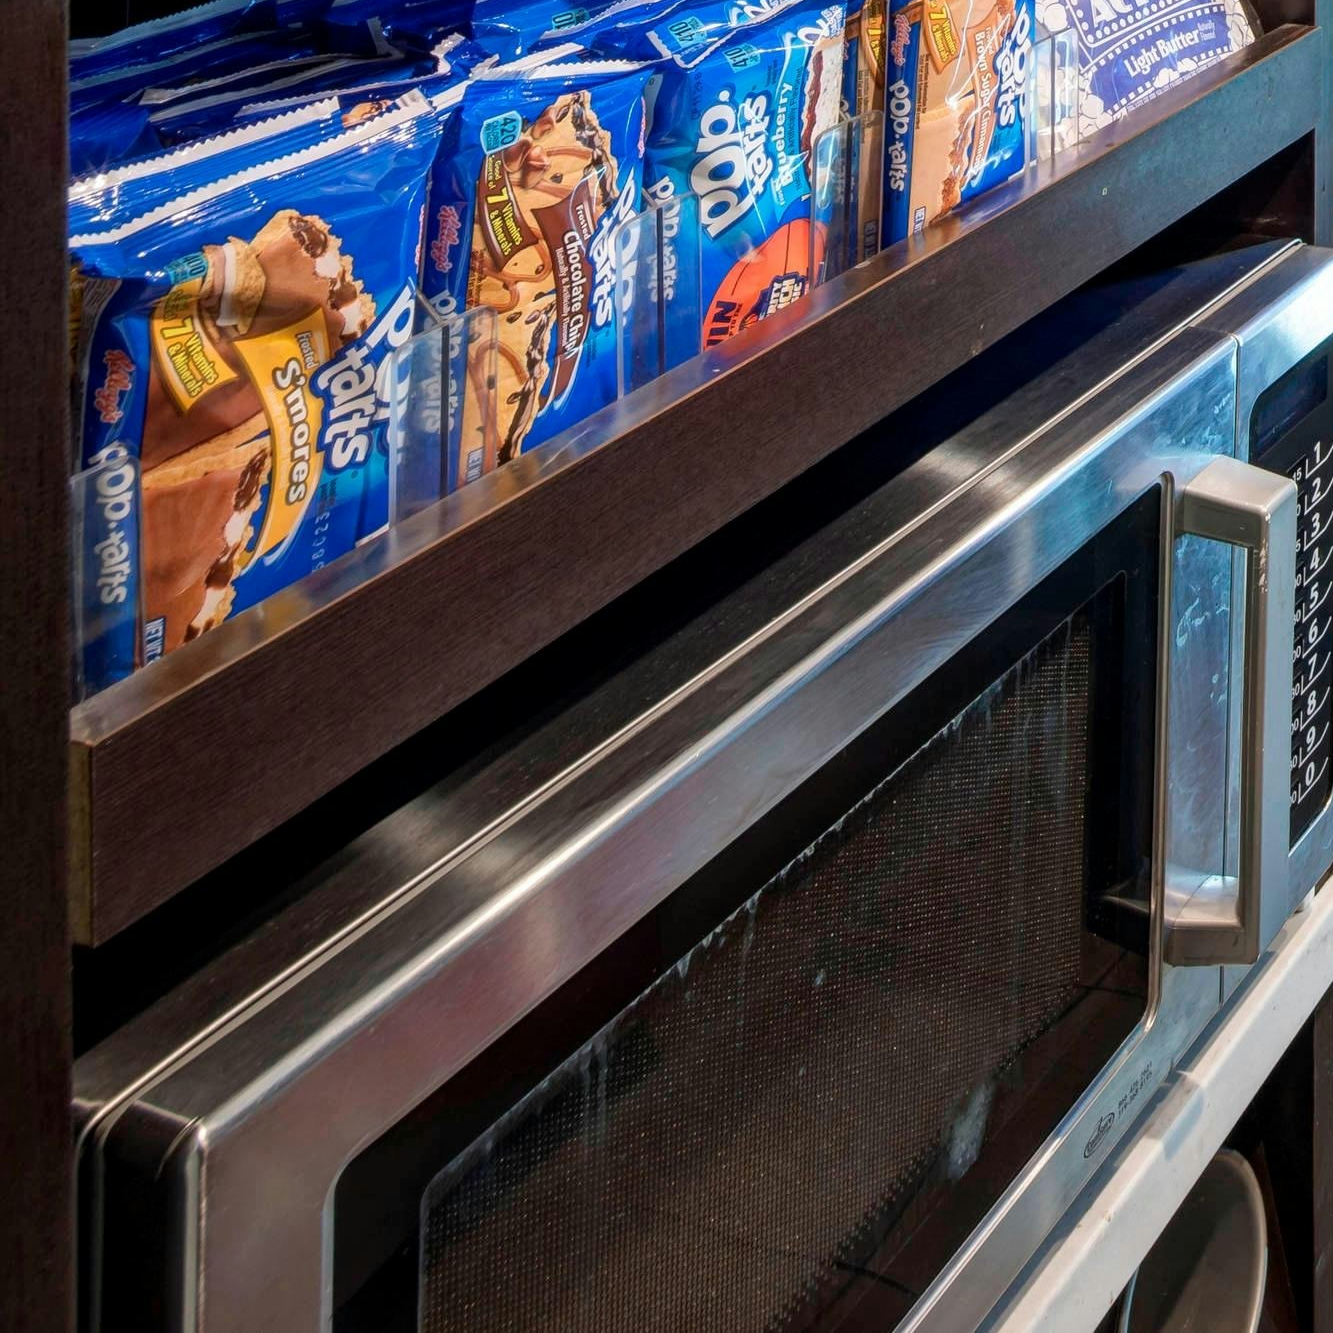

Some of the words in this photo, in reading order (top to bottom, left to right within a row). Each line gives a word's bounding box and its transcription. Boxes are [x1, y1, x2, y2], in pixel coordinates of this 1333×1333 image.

[927, 9, 951, 25] 7
[941, 20, 958, 57] Vitamins
[973, 29, 987, 71] Brown
[1123, 44, 1160, 78] Light
[1159, 28, 1201, 58] Butter
[995, 39, 1019, 128] tarts
[499, 117, 518, 147] 420
[771, 81, 795, 189] Blueberry
[485, 186, 509, 204] 7
[491, 216, 514, 257] Minerals
[501, 201, 524, 247] Vitamins
[575, 203, 591, 242] Frosted
[563, 229, 587, 312] Chocolate
[589, 216, 614, 327] tarts
[161, 317, 195, 341] 7
[184, 333, 219, 386] Vitamins
[296, 330, 320, 370] Frosted
[172, 347, 203, 398] Minerals
[317, 347, 377, 468] tarts
[273, 359, 309, 503] S'mores
[1314, 441, 1321, 463] 1
[1312, 477, 1321, 499] 2
[1311, 513, 1320, 534] 3
[1309, 548, 1320, 569] 4
[1309, 584, 1319, 605] 5
[1308, 620, 1318, 642] 6
[1307, 655, 1317, 677] 7
[1306, 690, 1316, 711] 8
[1305, 725, 1315, 747] 9
[1304, 760, 1315, 781] 0
